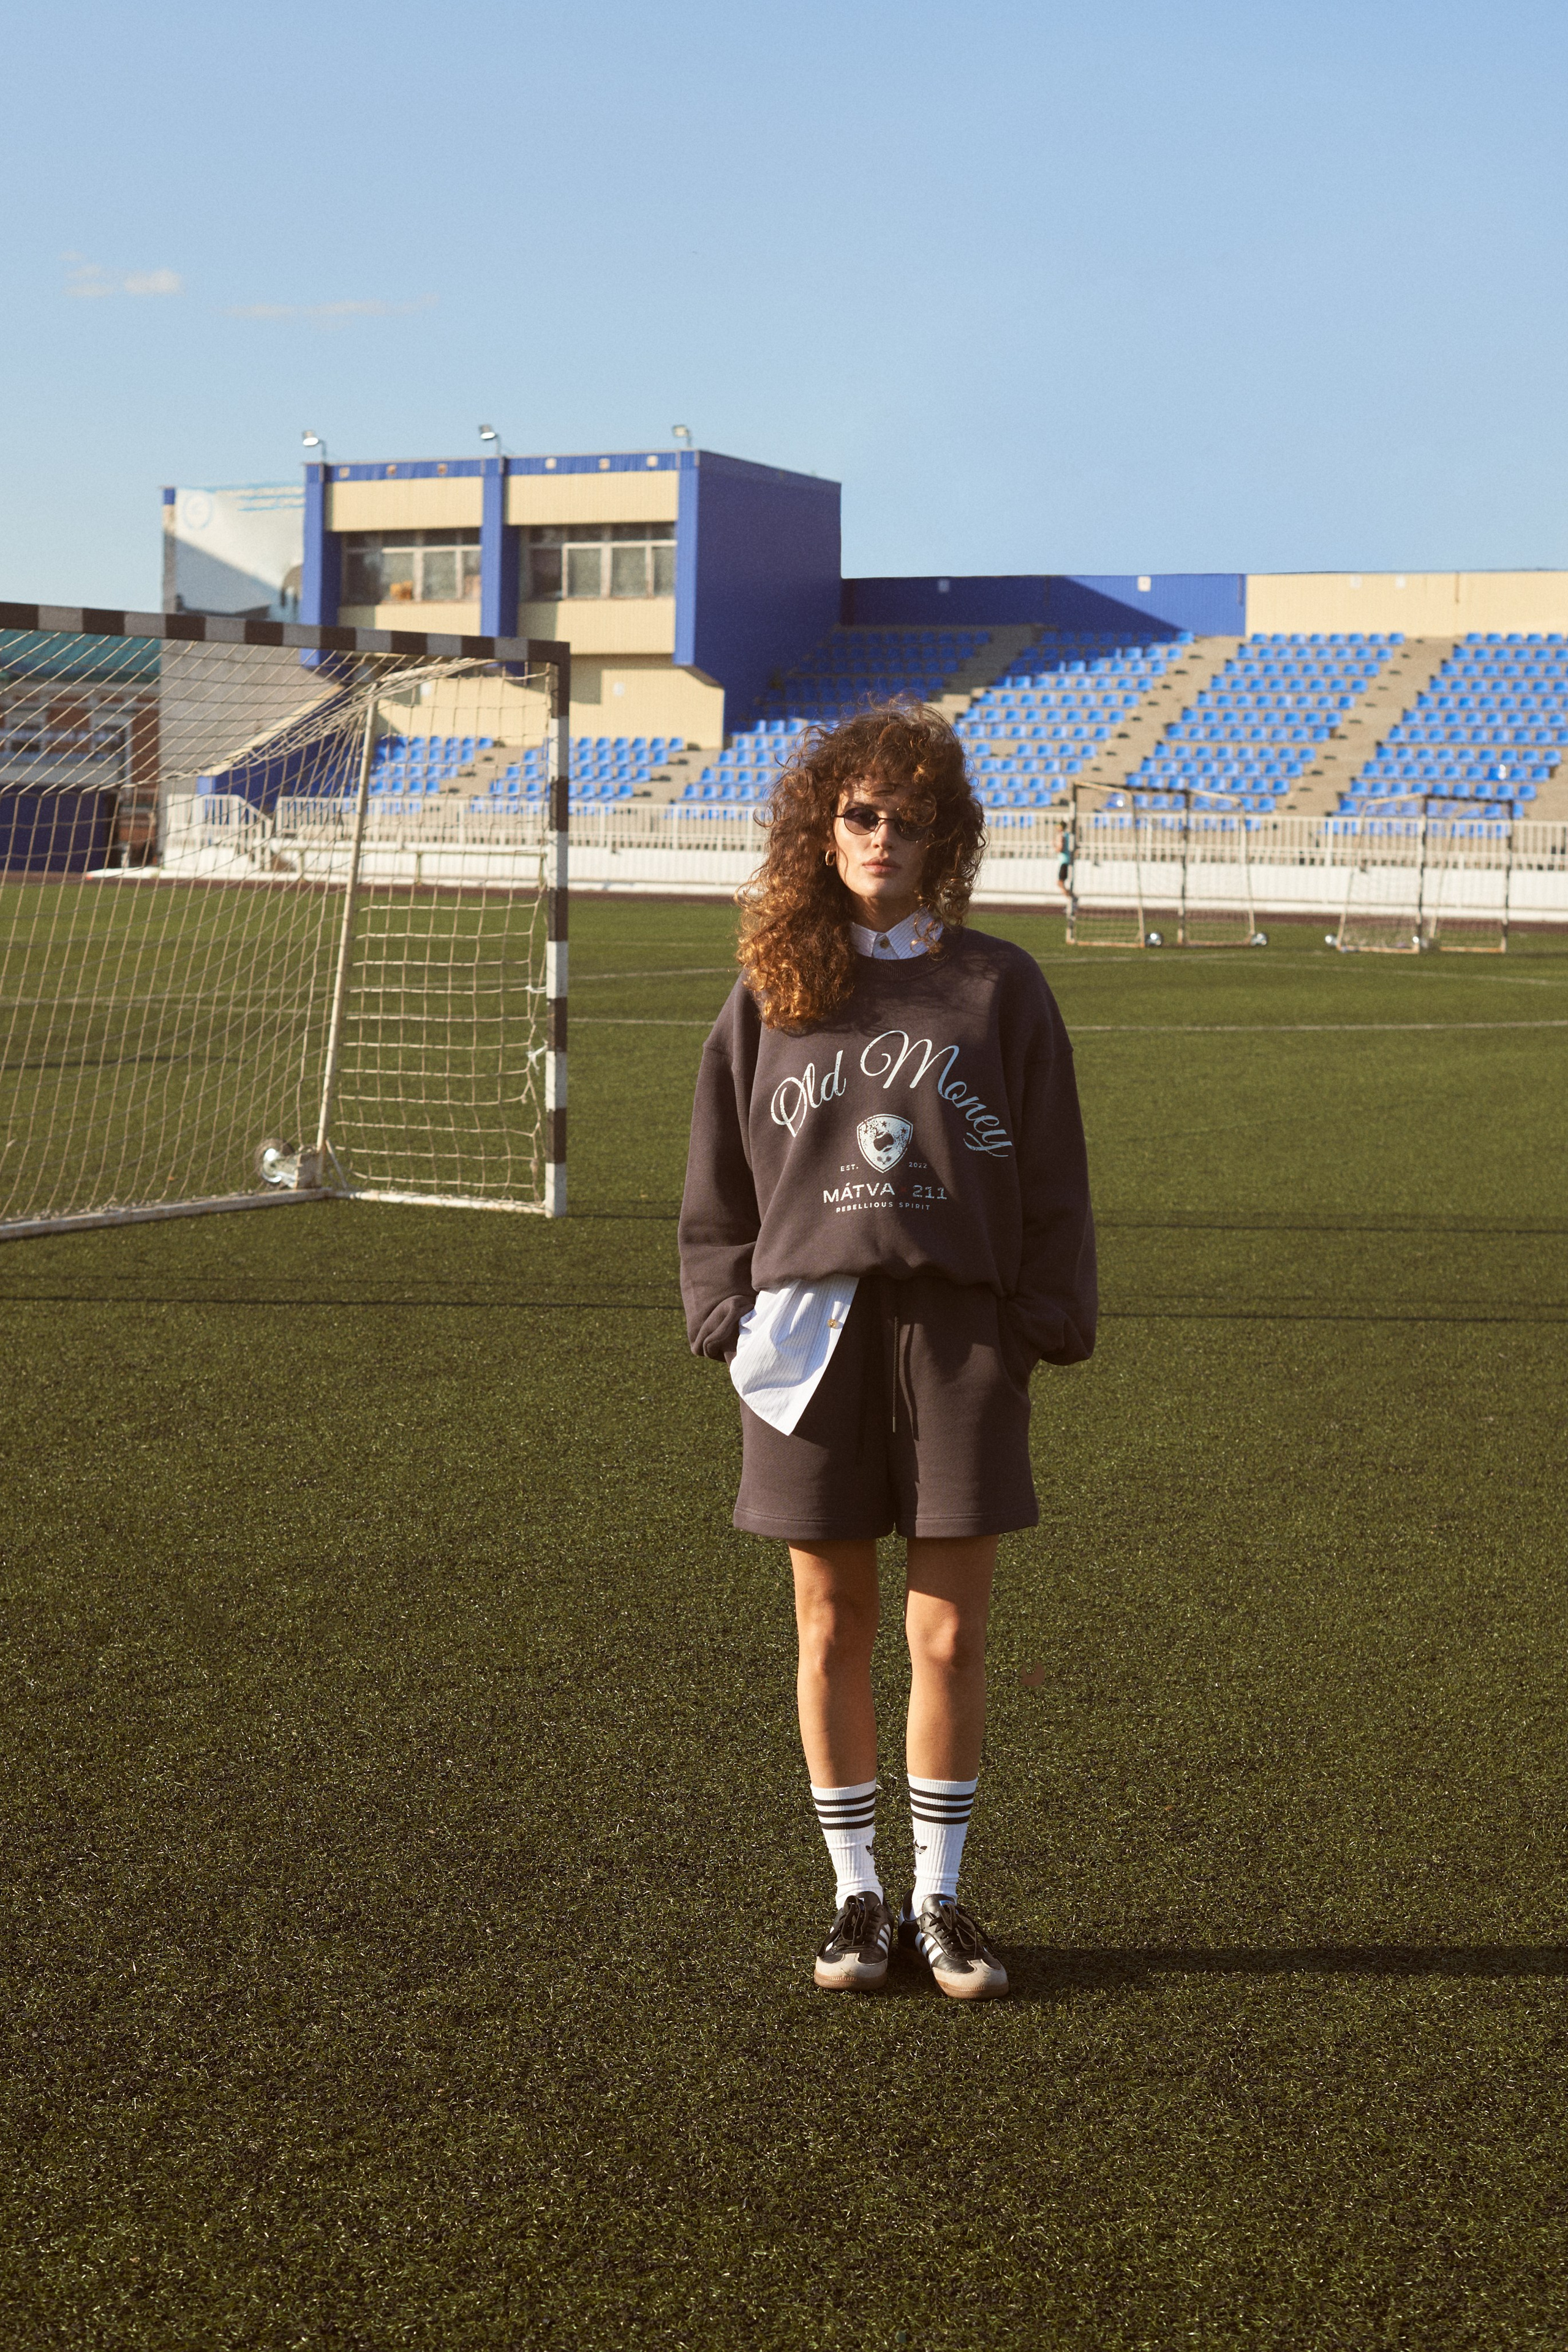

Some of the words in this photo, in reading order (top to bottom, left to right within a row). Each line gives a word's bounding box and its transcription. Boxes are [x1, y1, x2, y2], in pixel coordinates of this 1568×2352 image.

[771, 1050, 846, 1137] Old
[860, 1030, 1012, 1157] Money
[823, 1182, 895, 1204] MÁTVA
[912, 1184, 948, 1200] 211
[835, 1202, 894, 1213] REBELLIOUS
[899, 1202, 930, 1210] SPIRIT
